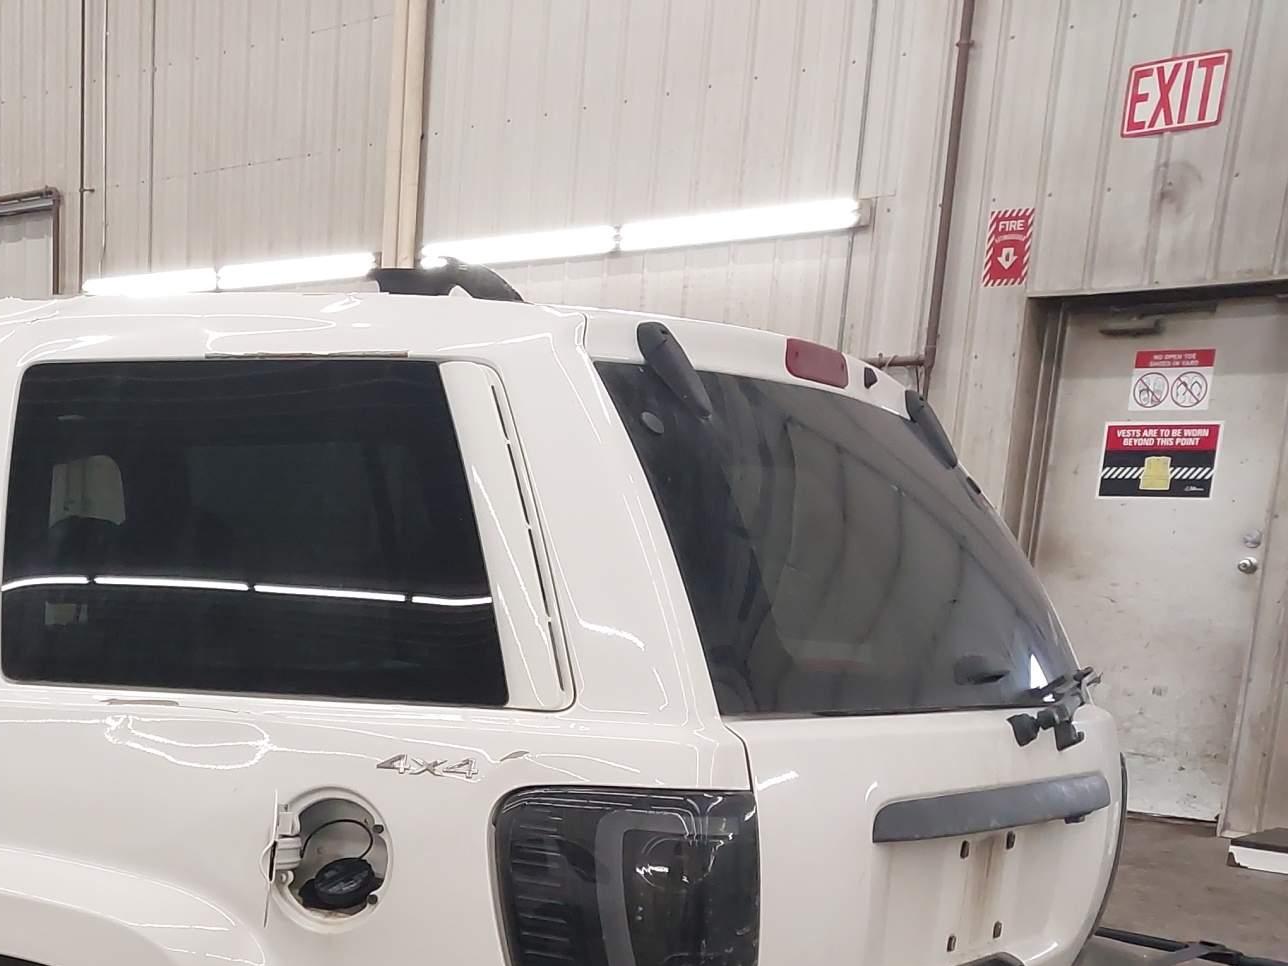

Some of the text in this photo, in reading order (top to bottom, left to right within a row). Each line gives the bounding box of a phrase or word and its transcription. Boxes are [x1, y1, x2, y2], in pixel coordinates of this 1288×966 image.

[1126, 55, 1226, 132] EXIT
[998, 219, 1025, 233] FIRE
[1116, 428, 1210, 438] VESTS ARE TO BE WORN
[1123, 437, 1201, 447] BEYOND THIS POINT
